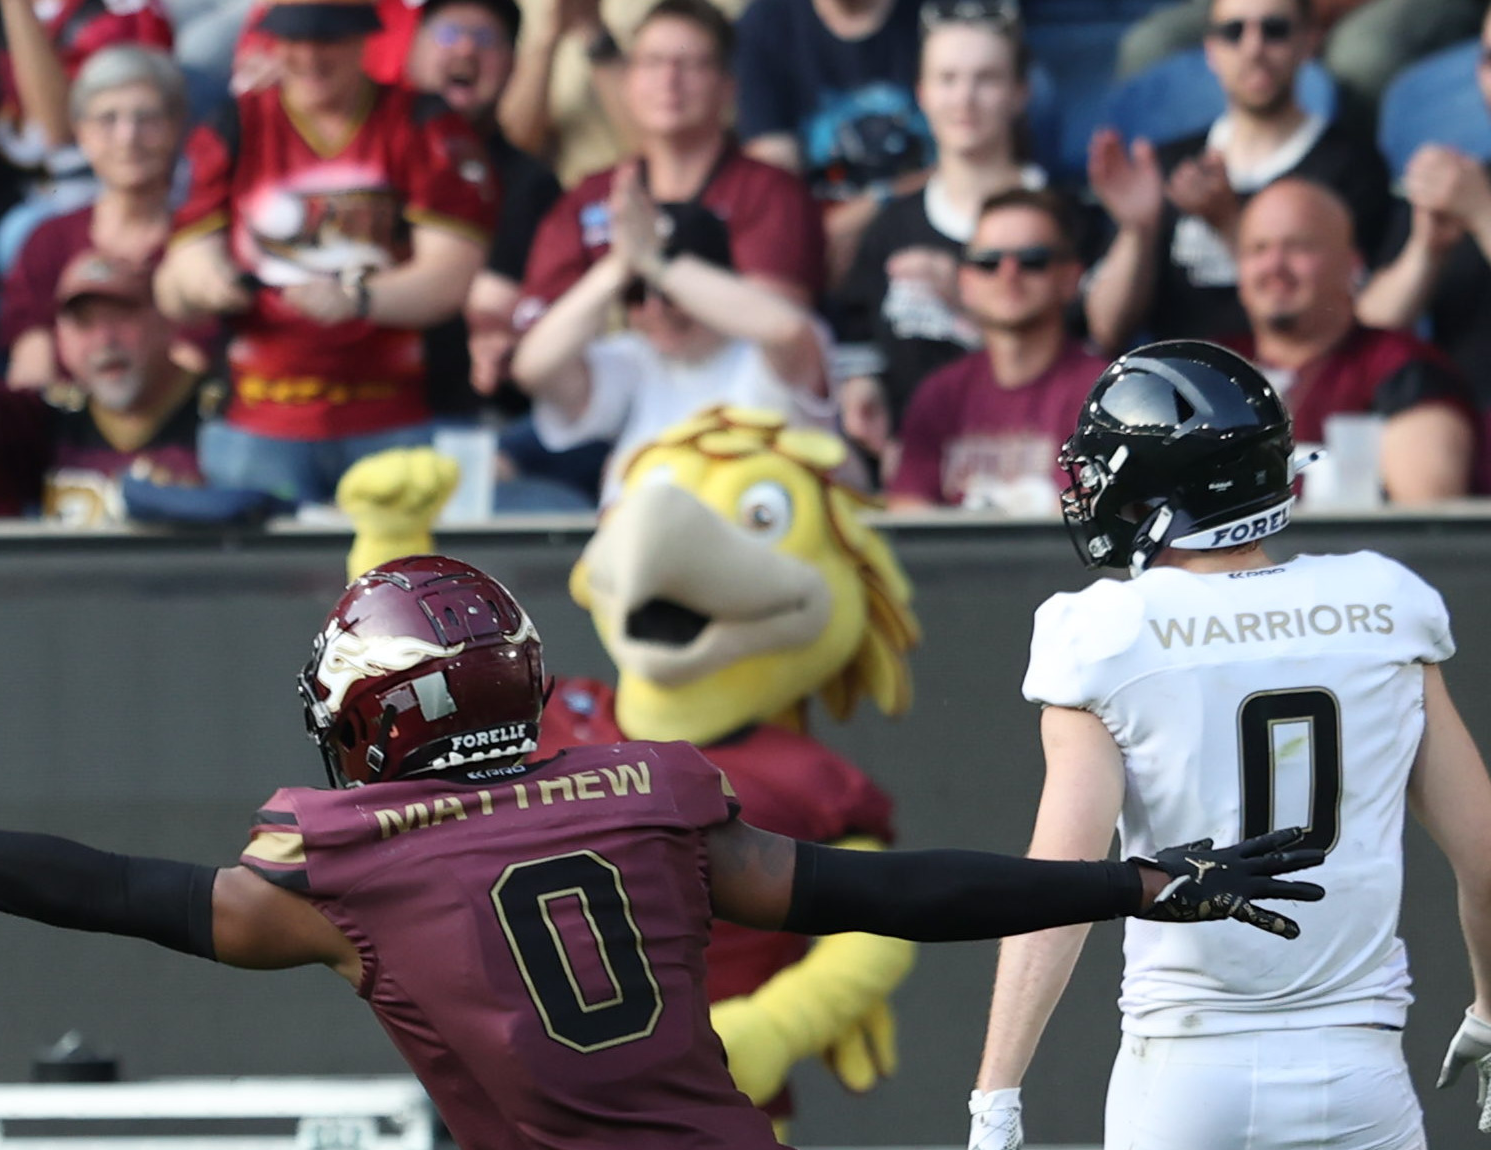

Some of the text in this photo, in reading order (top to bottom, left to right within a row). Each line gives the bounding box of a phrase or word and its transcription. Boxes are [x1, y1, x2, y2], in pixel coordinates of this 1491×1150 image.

[1150, 602, 1394, 650] WARRIORS
[451, 723, 526, 750] FORELLE
[1237, 685, 1343, 855] 0
[490, 848, 663, 1054] 0
